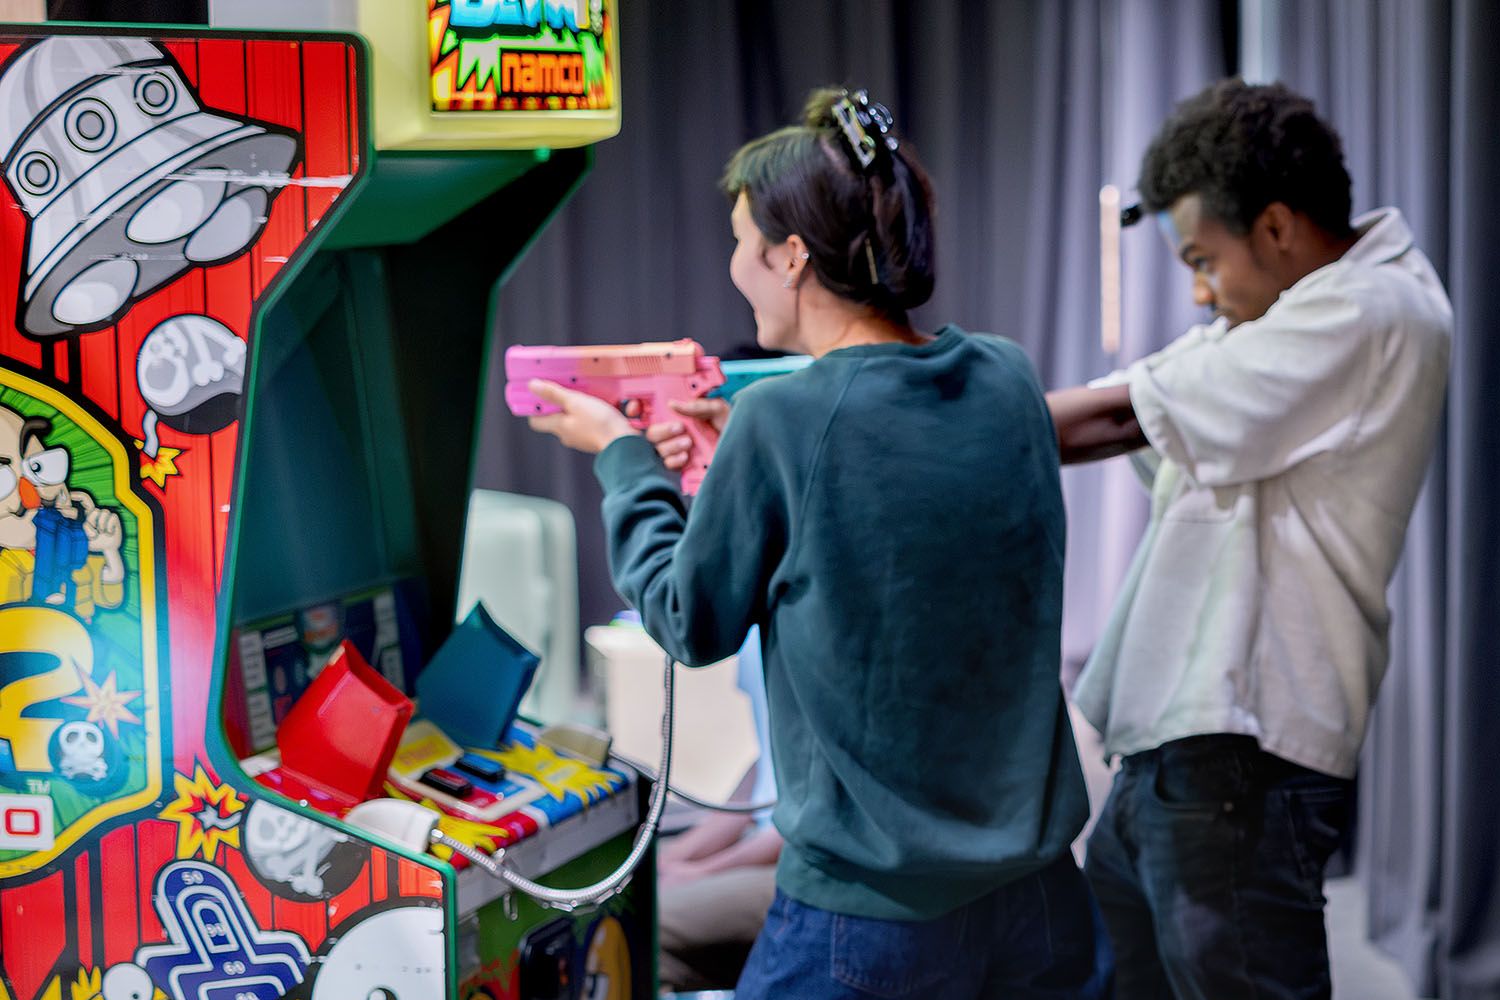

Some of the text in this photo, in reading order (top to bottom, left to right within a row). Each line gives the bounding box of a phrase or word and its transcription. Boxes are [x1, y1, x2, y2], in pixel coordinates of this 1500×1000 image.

[501, 52, 584, 93] namco
[25, 779, 52, 794] TM
[181, 870, 205, 886] 50
[222, 960, 247, 976] 60
